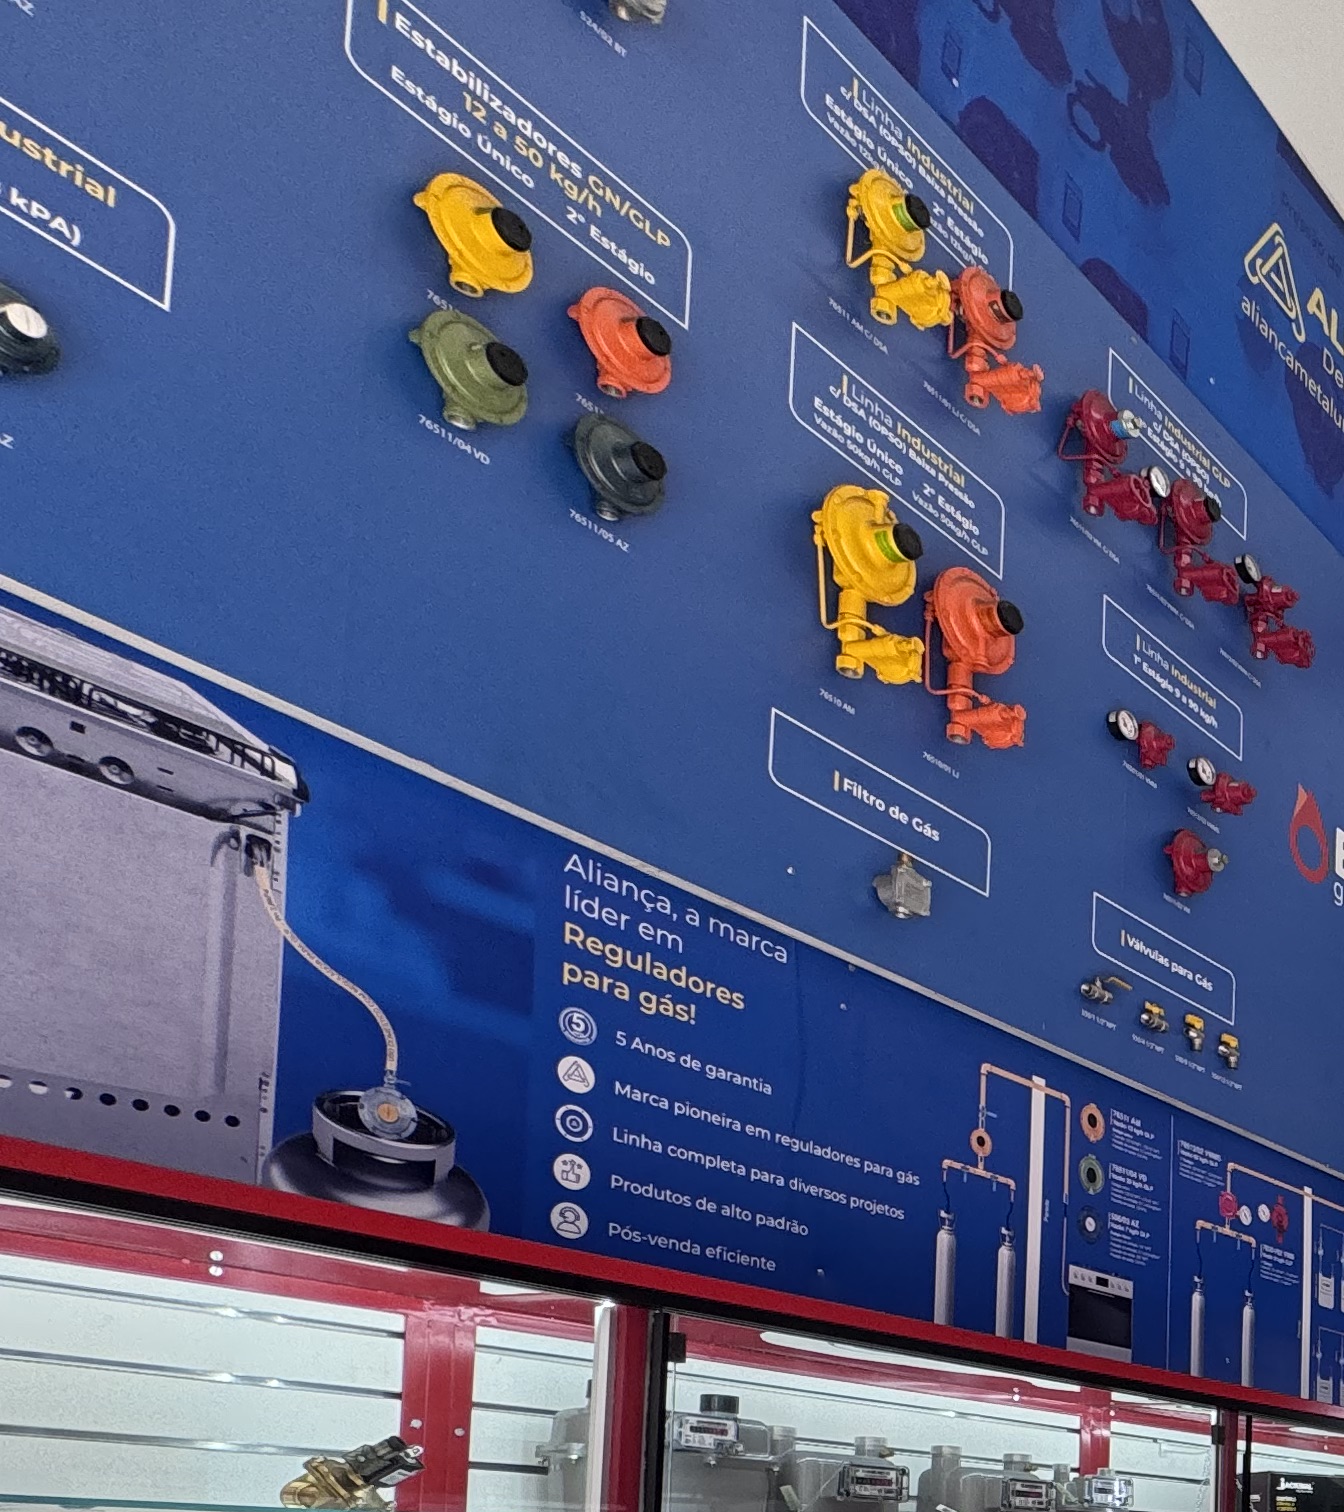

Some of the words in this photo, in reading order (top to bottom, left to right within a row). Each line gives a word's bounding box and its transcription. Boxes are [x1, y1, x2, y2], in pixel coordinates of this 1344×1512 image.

[390, 65, 472, 138] Estágio
[476, 131, 535, 189] Único
[589, 224, 656, 286] Estágio
[394, 12, 583, 179] Estabilizadores
[587, 174, 671, 248] GN/GLP
[462, 91, 488, 125] 12
[493, 122, 508, 142] a
[513, 135, 544, 168] 50
[549, 163, 603, 217] kg/h
[853, 98, 878, 129] DSA
[918, 165, 946, 199] Baixa
[862, 90, 903, 141] Linha
[907, 136, 975, 216] Industrial
[10, 187, 81, 247] kPA)
[825, 94, 875, 150] Estágio
[877, 145, 914, 190] Único
[947, 217, 989, 265] Estágio
[472, 446, 491, 466] VD
[813, 413, 845, 444] Vazão
[882, 467, 903, 487] GLP
[911, 490, 940, 517] Vazão
[814, 397, 864, 444] Estágio
[867, 437, 904, 476] Único
[937, 494, 980, 536] Estágio
[843, 395, 867, 423] DSA
[868, 415, 907, 455] (OPSO)
[908, 450, 936, 477] Baixa
[938, 474, 975, 509] Pressão
[851, 383, 893, 427] Linha
[896, 421, 965, 488] Industrial
[1135, 385, 1163, 420] Linha
[1164, 416, 1211, 470] Industrial
[1212, 465, 1231, 488] GLP
[1142, 639, 1170, 672] Linha
[1171, 662, 1217, 710] Industrial
[1142, 660, 1174, 692] Estágio
[843, 777, 886, 813] Filtro
[888, 805, 910, 825] de
[911, 817, 940, 842] Gás
[563, 853, 679, 922] Aliança,
[685, 908, 700, 928] a
[709, 916, 788, 965] marca
[564, 884, 631, 931] líder
[638, 921, 683, 954] em
[562, 962, 630, 1002] para
[639, 990, 697, 1026] gás!
[563, 921, 746, 1010] Reguladores
[1126, 932, 1170, 968] Válvulas
[1171, 961, 1194, 982] para
[1195, 974, 1214, 992] Gás
[615, 1031, 627, 1047] 5
[630, 1036, 677, 1065] Anos
[679, 1053, 702, 1072] de
[705, 1061, 773, 1096] garantia
[612, 1127, 663, 1154] Linha
[667, 1143, 747, 1178] completa
[750, 1165, 785, 1188] para
[789, 1174, 847, 1205] diversos
[850, 1193, 906, 1221] projetos
[614, 1080, 669, 1111] Marca
[673, 1101, 742, 1133] pioneira
[745, 1123, 772, 1142] em
[775, 1130, 861, 1169] reguladores
[864, 1158, 894, 1180] para
[896, 1167, 921, 1187] gás
[608, 1223, 702, 1256] Pós-venda
[705, 1246, 777, 1273] eficiente
[610, 1174, 693, 1208] Produtos
[695, 1194, 718, 1213] de
[721, 1202, 752, 1222] alto
[755, 1211, 810, 1237] padrão
